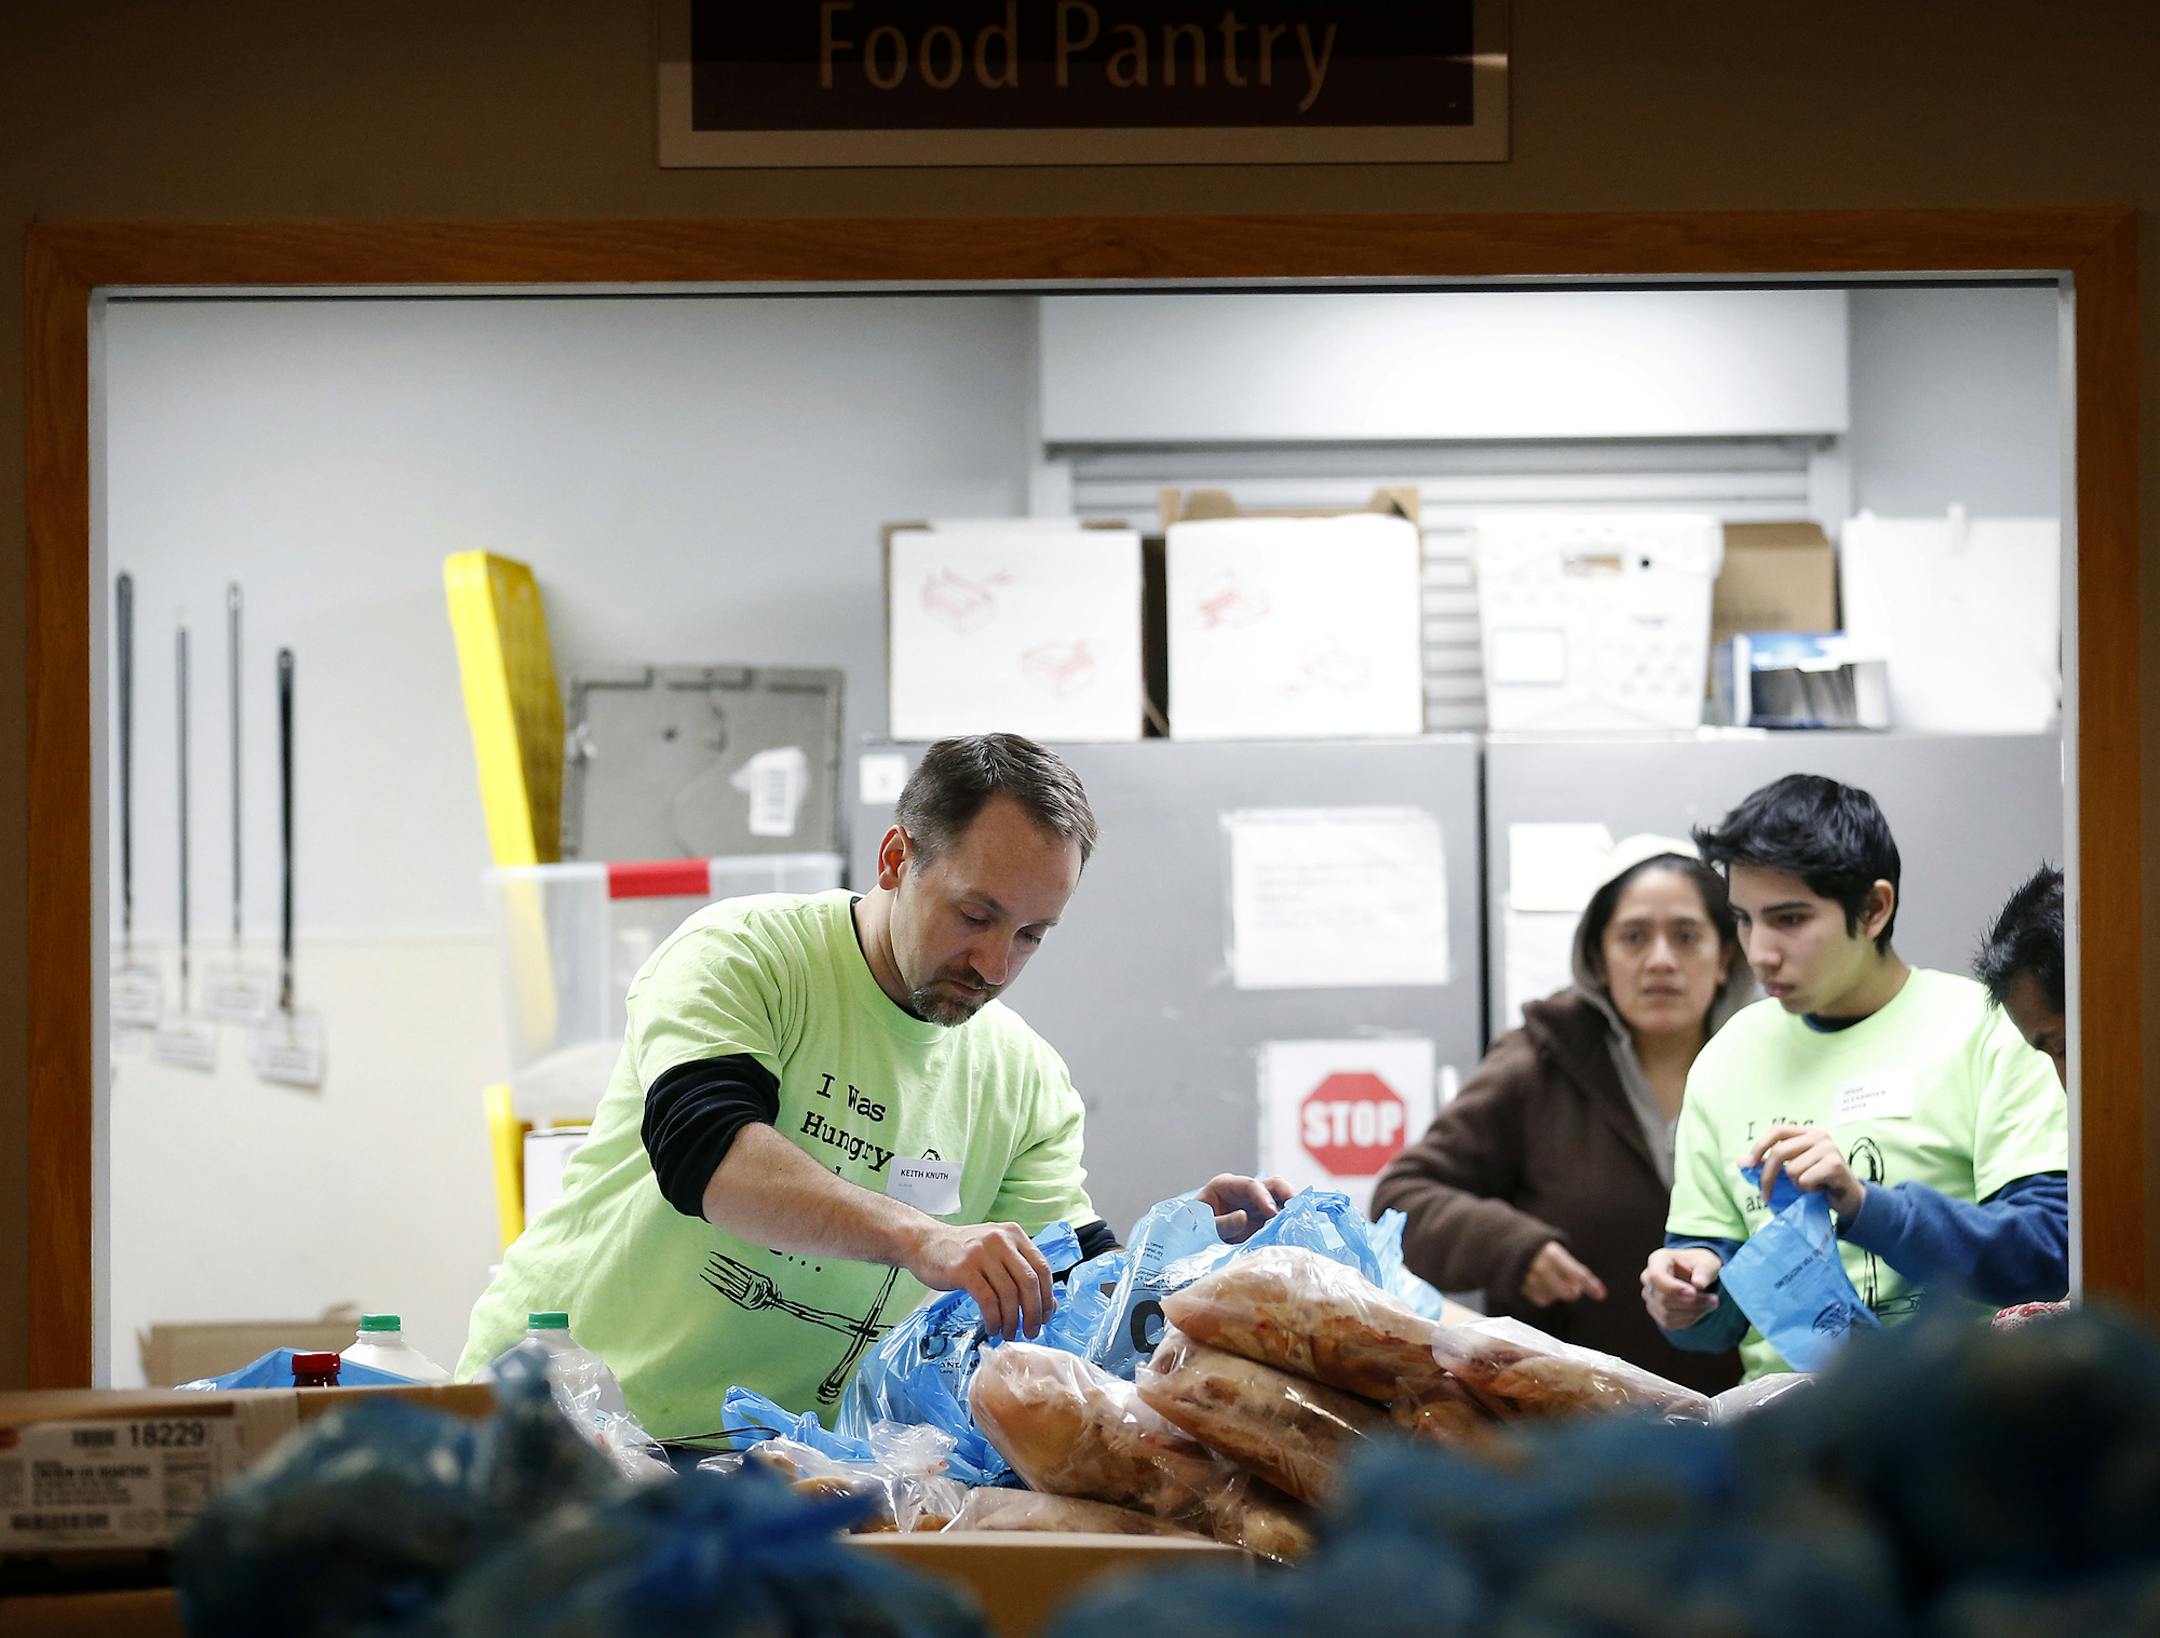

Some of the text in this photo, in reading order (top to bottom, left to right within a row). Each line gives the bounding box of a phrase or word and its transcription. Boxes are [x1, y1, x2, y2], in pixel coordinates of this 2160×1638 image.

[818, 0, 1338, 114] Food Pantry
[816, 1073, 886, 1122] I Was
[800, 1111, 895, 1172] Hungry
[1303, 1101, 1403, 1147] STOP
[900, 1169, 949, 1181] KEITH KNUTH
[130, 1421, 205, 1447] 18229
